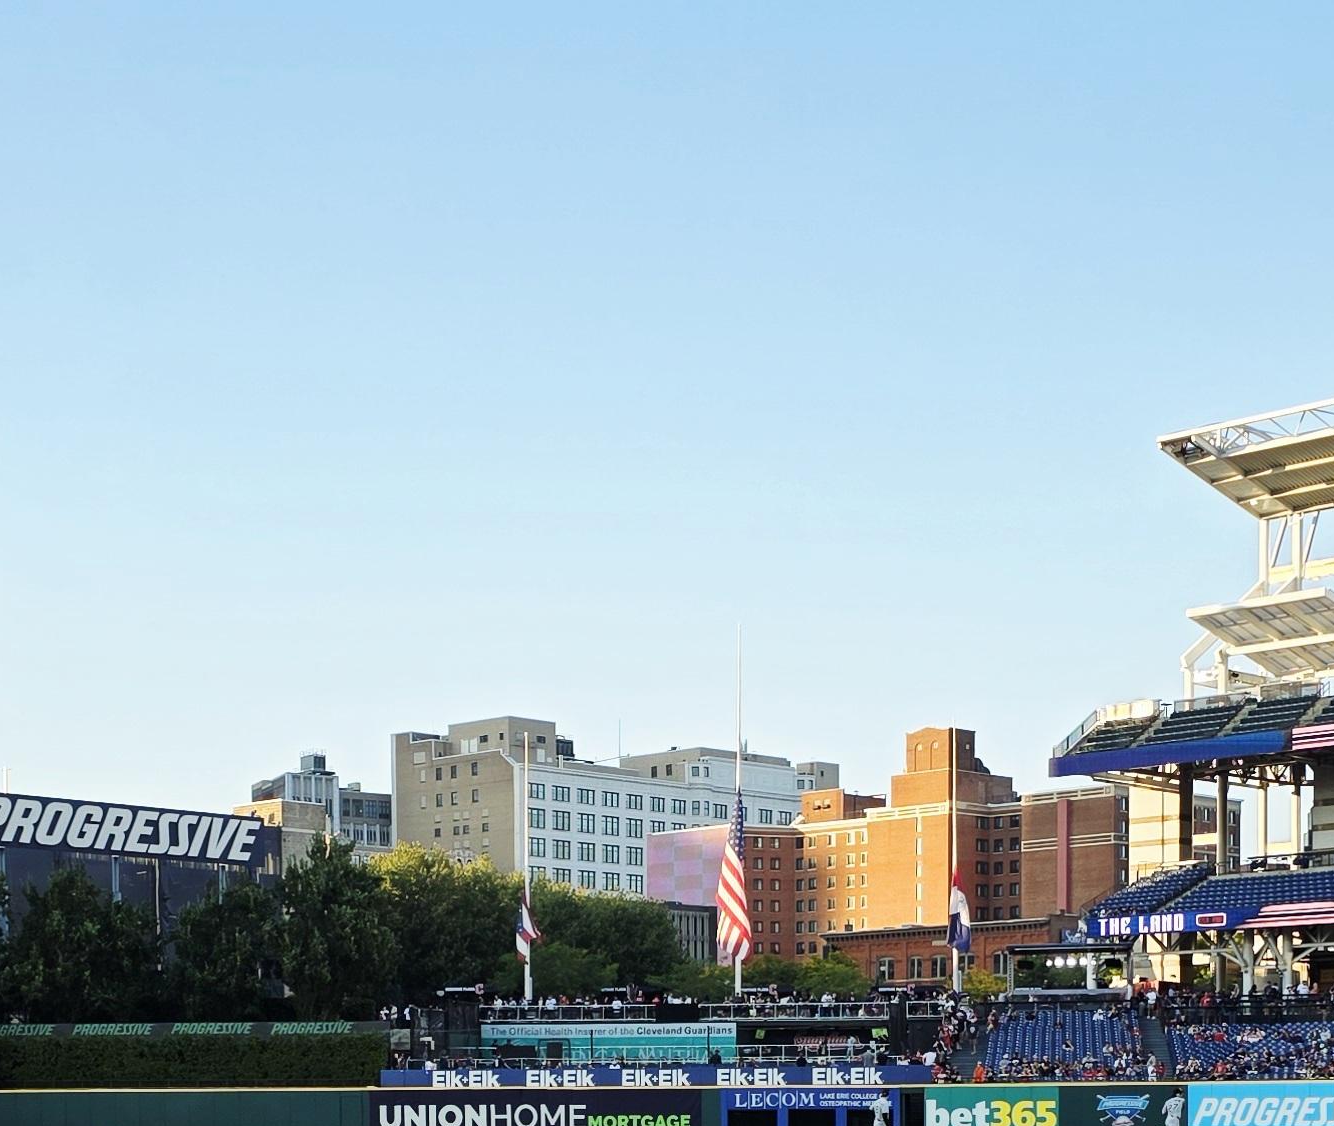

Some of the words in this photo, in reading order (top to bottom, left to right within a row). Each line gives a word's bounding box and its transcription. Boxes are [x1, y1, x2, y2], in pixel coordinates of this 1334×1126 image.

[1098, 916, 1132, 937] THE
[1138, 913, 1184, 934] LAND
[72, 1023, 154, 1036] PROGRESSIVE
[171, 1022, 253, 1034] PROGRESSIVE
[270, 1021, 355, 1035] PROGRESSIVE
[490, 1028, 507, 1036] The
[509, 1027, 542, 1036] Official
[544, 1027, 574, 1036] Health
[609, 1027, 618, 1035] of
[619, 1027, 635, 1035] the
[636, 1026, 682, 1035] Cleveland
[684, 1026, 734, 1035] Guardians
